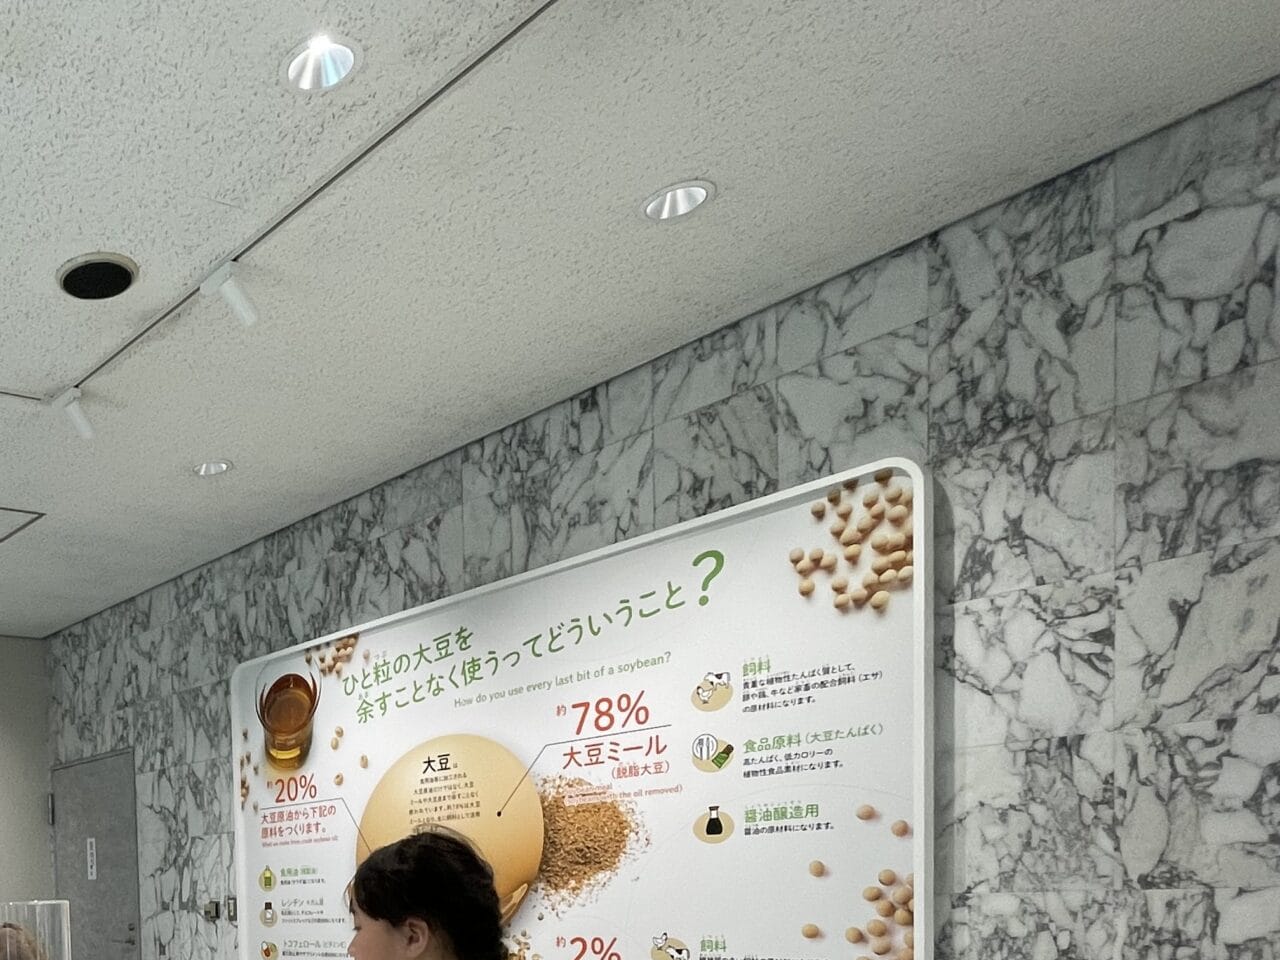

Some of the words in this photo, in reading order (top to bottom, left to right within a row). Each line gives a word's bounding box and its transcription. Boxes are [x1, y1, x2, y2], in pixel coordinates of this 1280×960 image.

[356, 550, 725, 724] 余すことなく使うってどういうこと？
[342, 625, 474, 696] ひと粒の大豆を
[742, 658, 770, 677] 飼料
[454, 696, 472, 708] How
[475, 692, 487, 704] do
[489, 689, 506, 705] you
[508, 686, 524, 698] use
[526, 679, 552, 695] every
[555, 672, 573, 686] last
[576, 668, 591, 683] bit
[593, 665, 606, 679] of
[608, 667, 615, 675] a
[617, 651, 672, 674] soybean?
[562, 734, 668, 769] 大豆ミール
[743, 723, 884, 754] 食品原料（大豆たんぱく）
[611, 760, 670, 779] （脱脂大豆）
